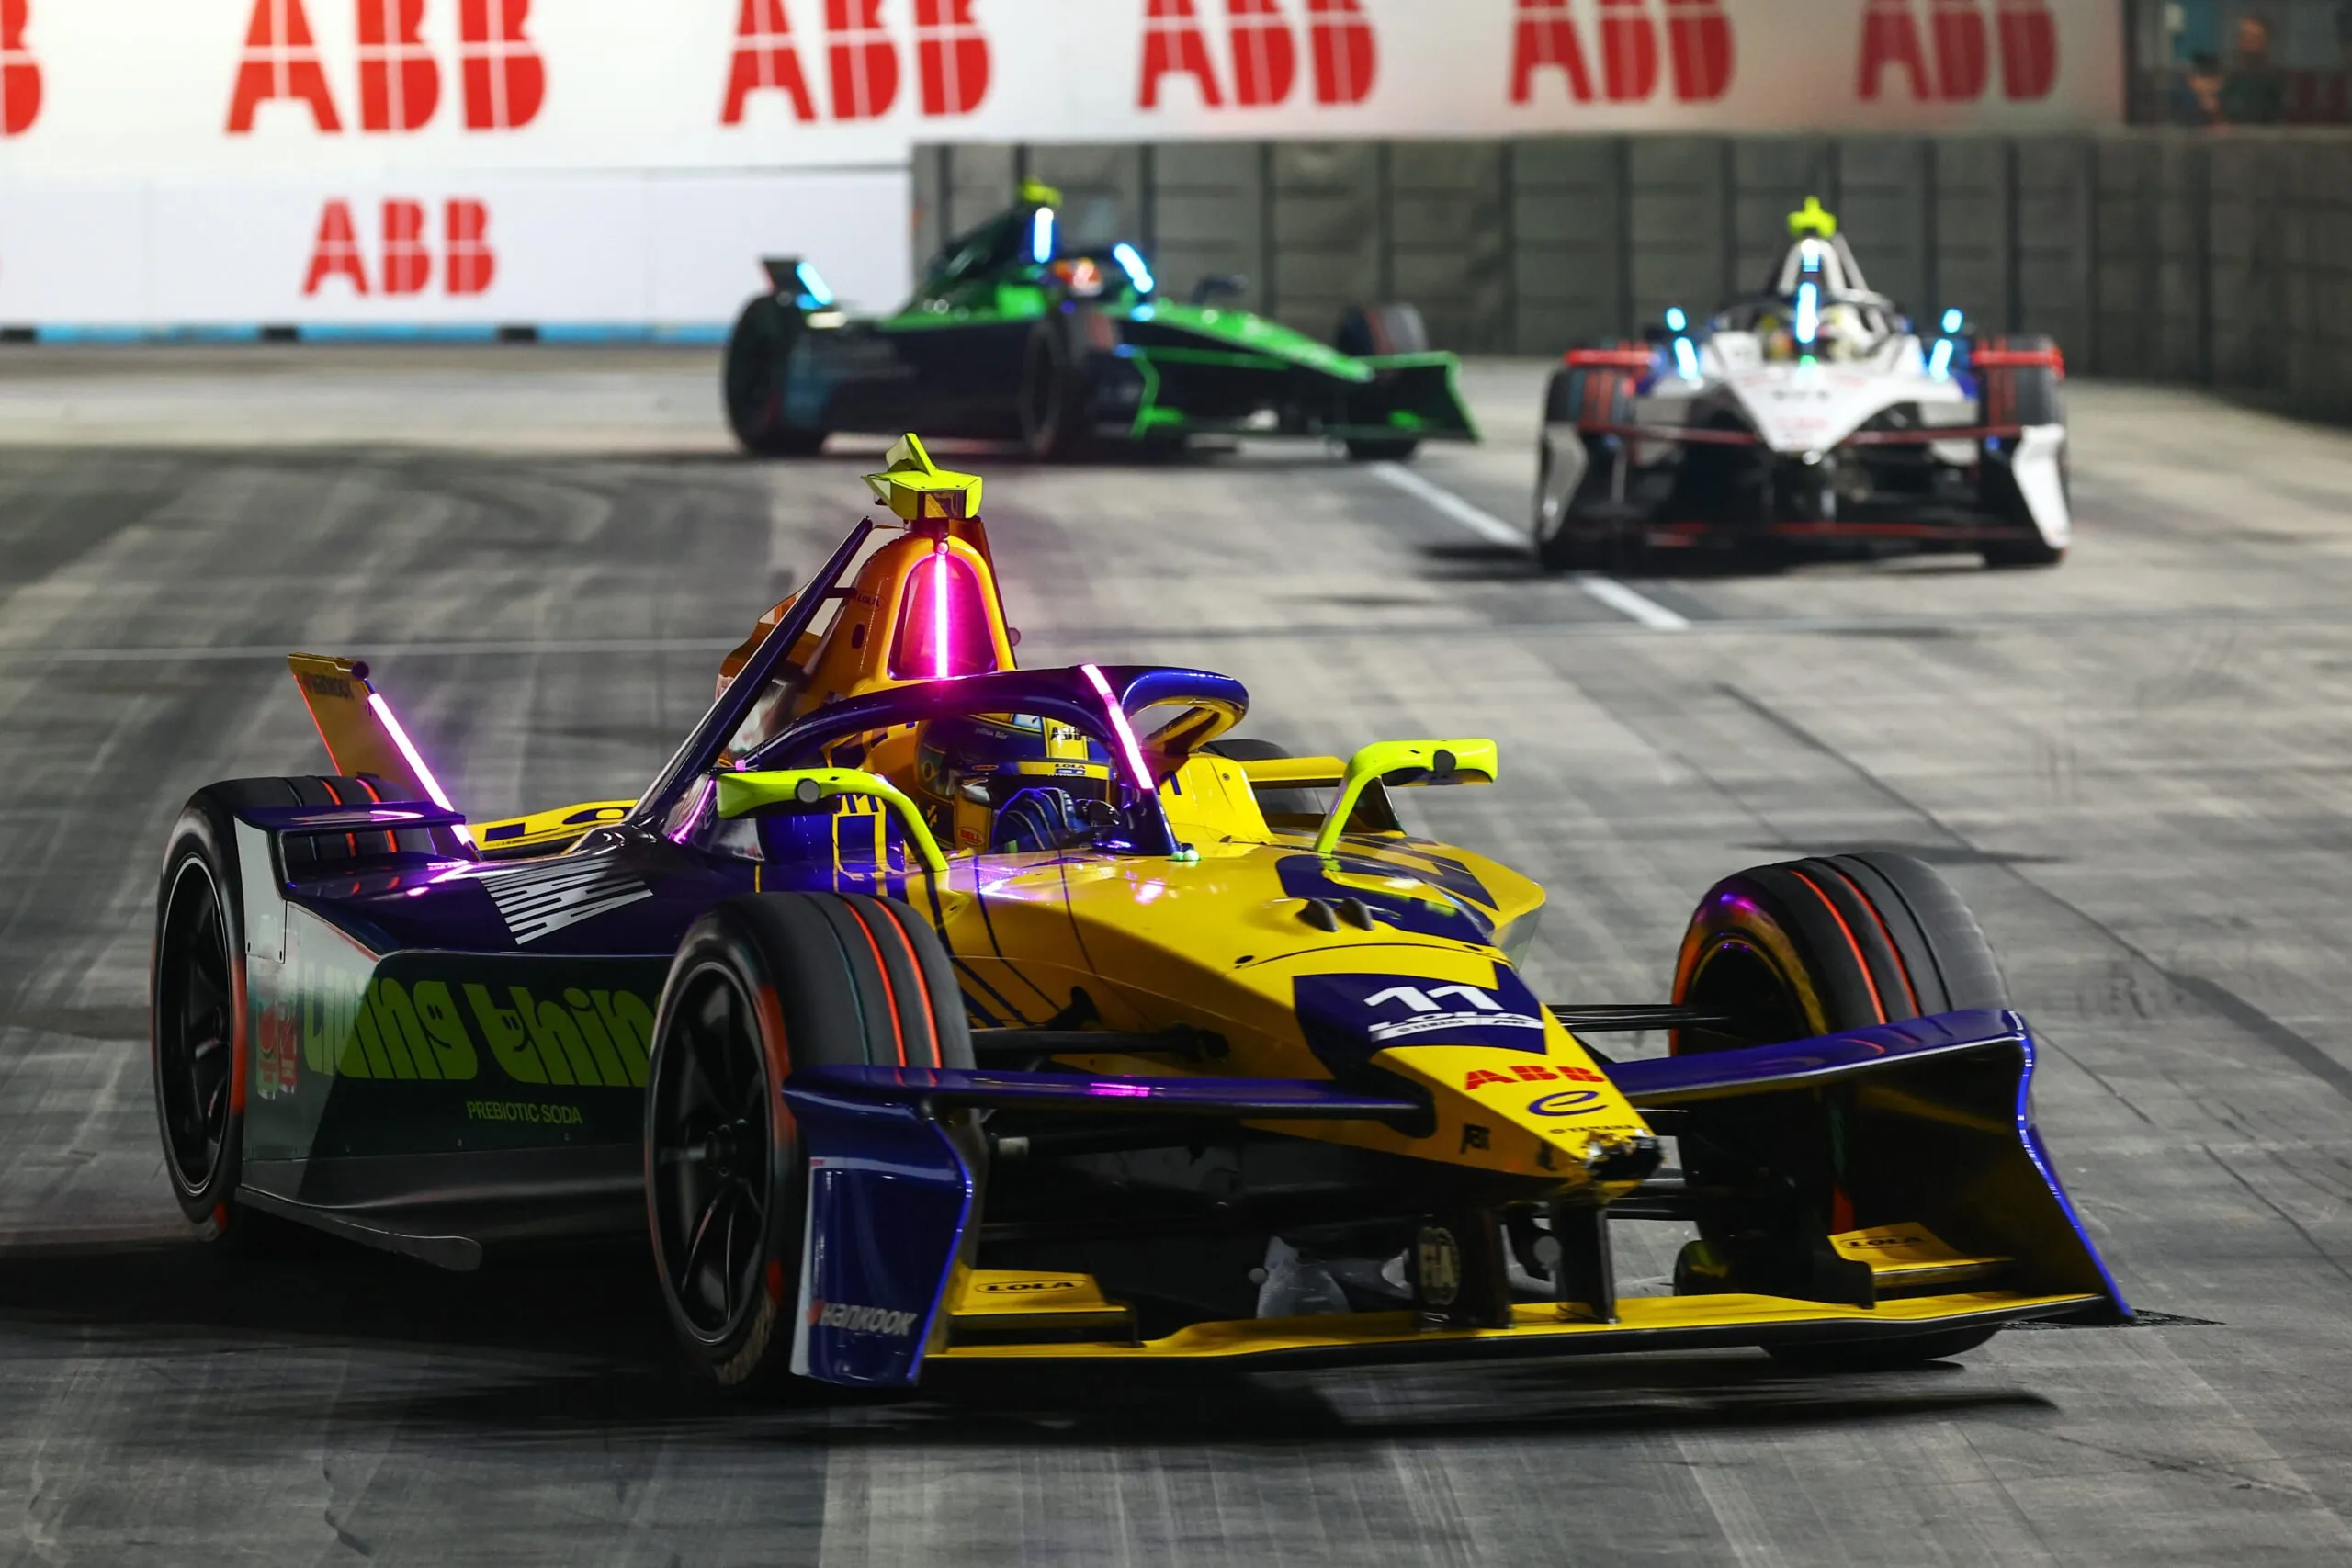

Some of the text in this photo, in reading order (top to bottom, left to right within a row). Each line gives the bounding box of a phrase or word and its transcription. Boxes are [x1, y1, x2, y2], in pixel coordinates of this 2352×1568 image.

[226, 0, 548, 133] ABB
[720, 0, 992, 125] ABB
[1137, 0, 1378, 108] ABB
[1509, 0, 1736, 105] ABB
[302, 197, 496, 297] ABB
[1363, 985, 1505, 1012] 11
[467, 1100, 583, 1124] PREBIOTIC SODA
[1464, 1065, 1605, 1090] ABB
[987, 1280, 1076, 1292] LOLA
